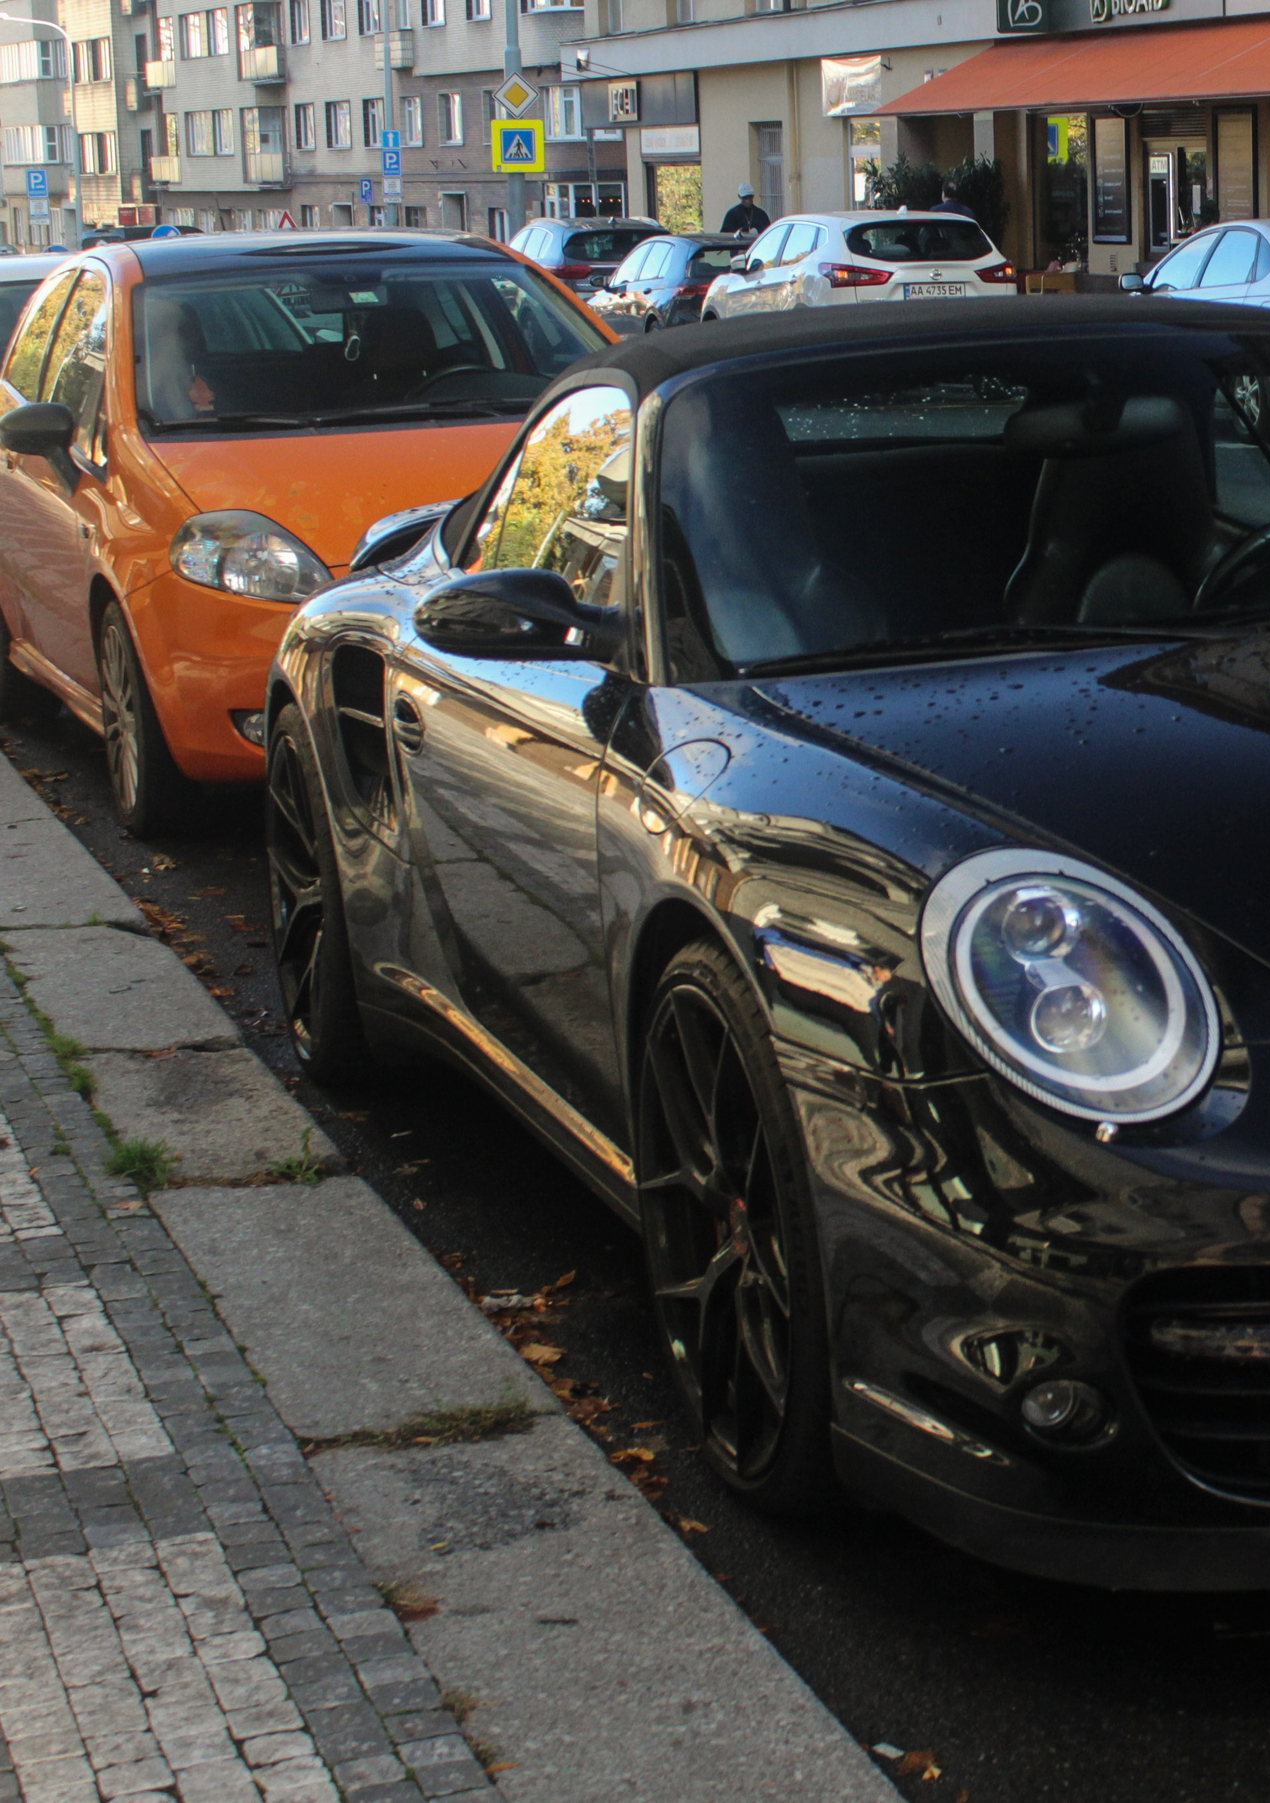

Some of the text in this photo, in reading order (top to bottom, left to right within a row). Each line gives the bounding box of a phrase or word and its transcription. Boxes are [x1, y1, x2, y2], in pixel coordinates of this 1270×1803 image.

[385, 153, 397, 169] P
[1151, 158, 1168, 172] ATM
[30, 172, 43, 189] P
[362, 181, 370, 195] P
[910, 286, 962, 296] AA 4735 EM
